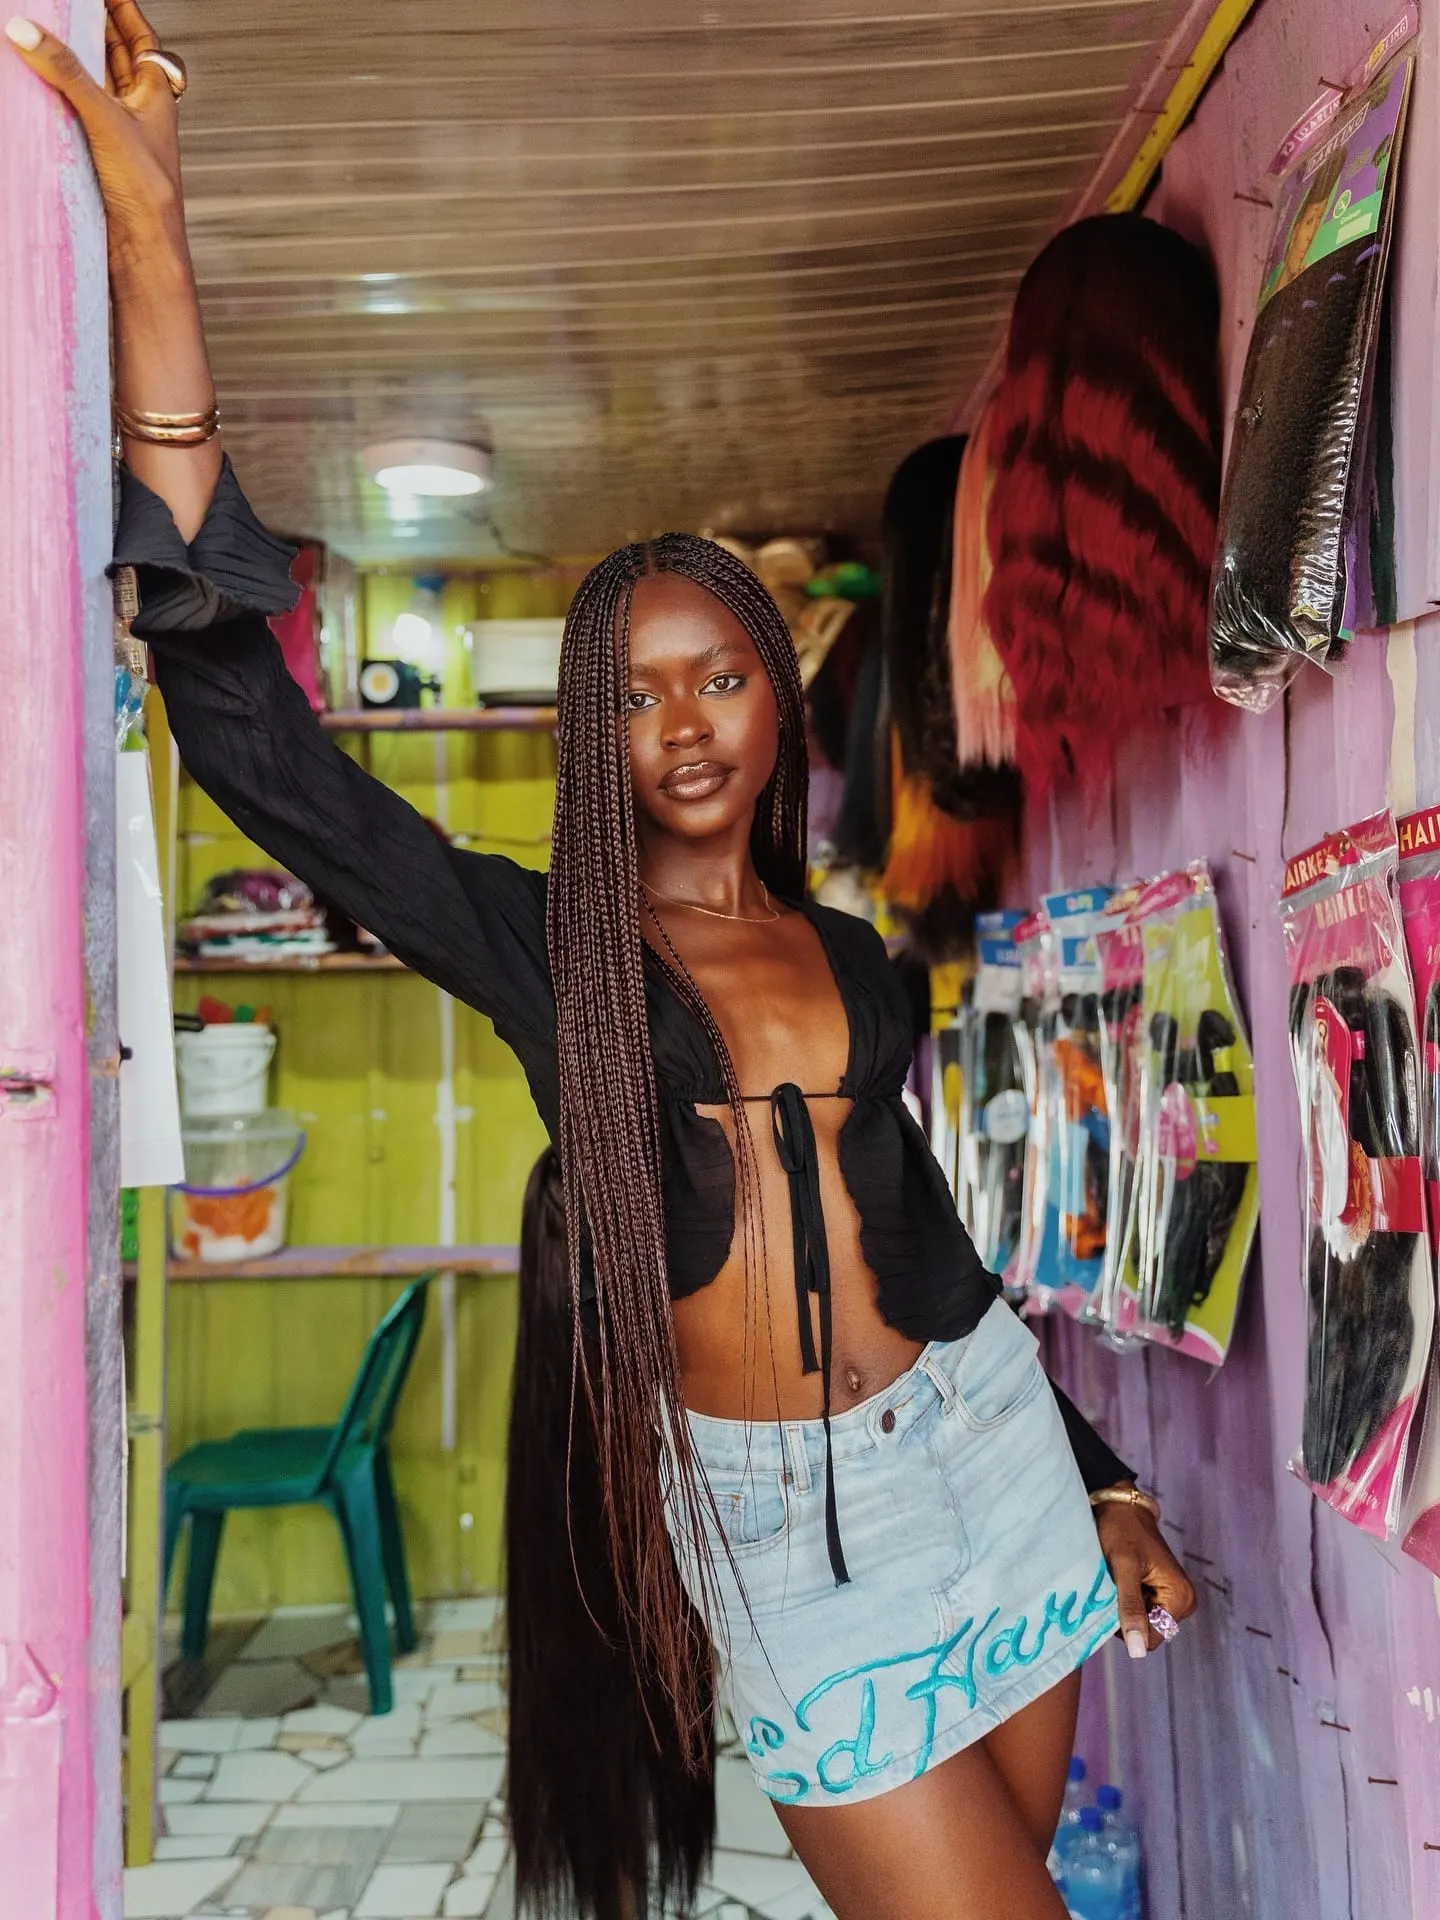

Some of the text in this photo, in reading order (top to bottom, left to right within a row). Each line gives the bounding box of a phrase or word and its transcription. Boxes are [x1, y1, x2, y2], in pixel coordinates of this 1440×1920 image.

[1297, 97, 1342, 141] DARLIN
[1305, 108, 1365, 174] DARLING
[1399, 813, 1440, 853] HAI
